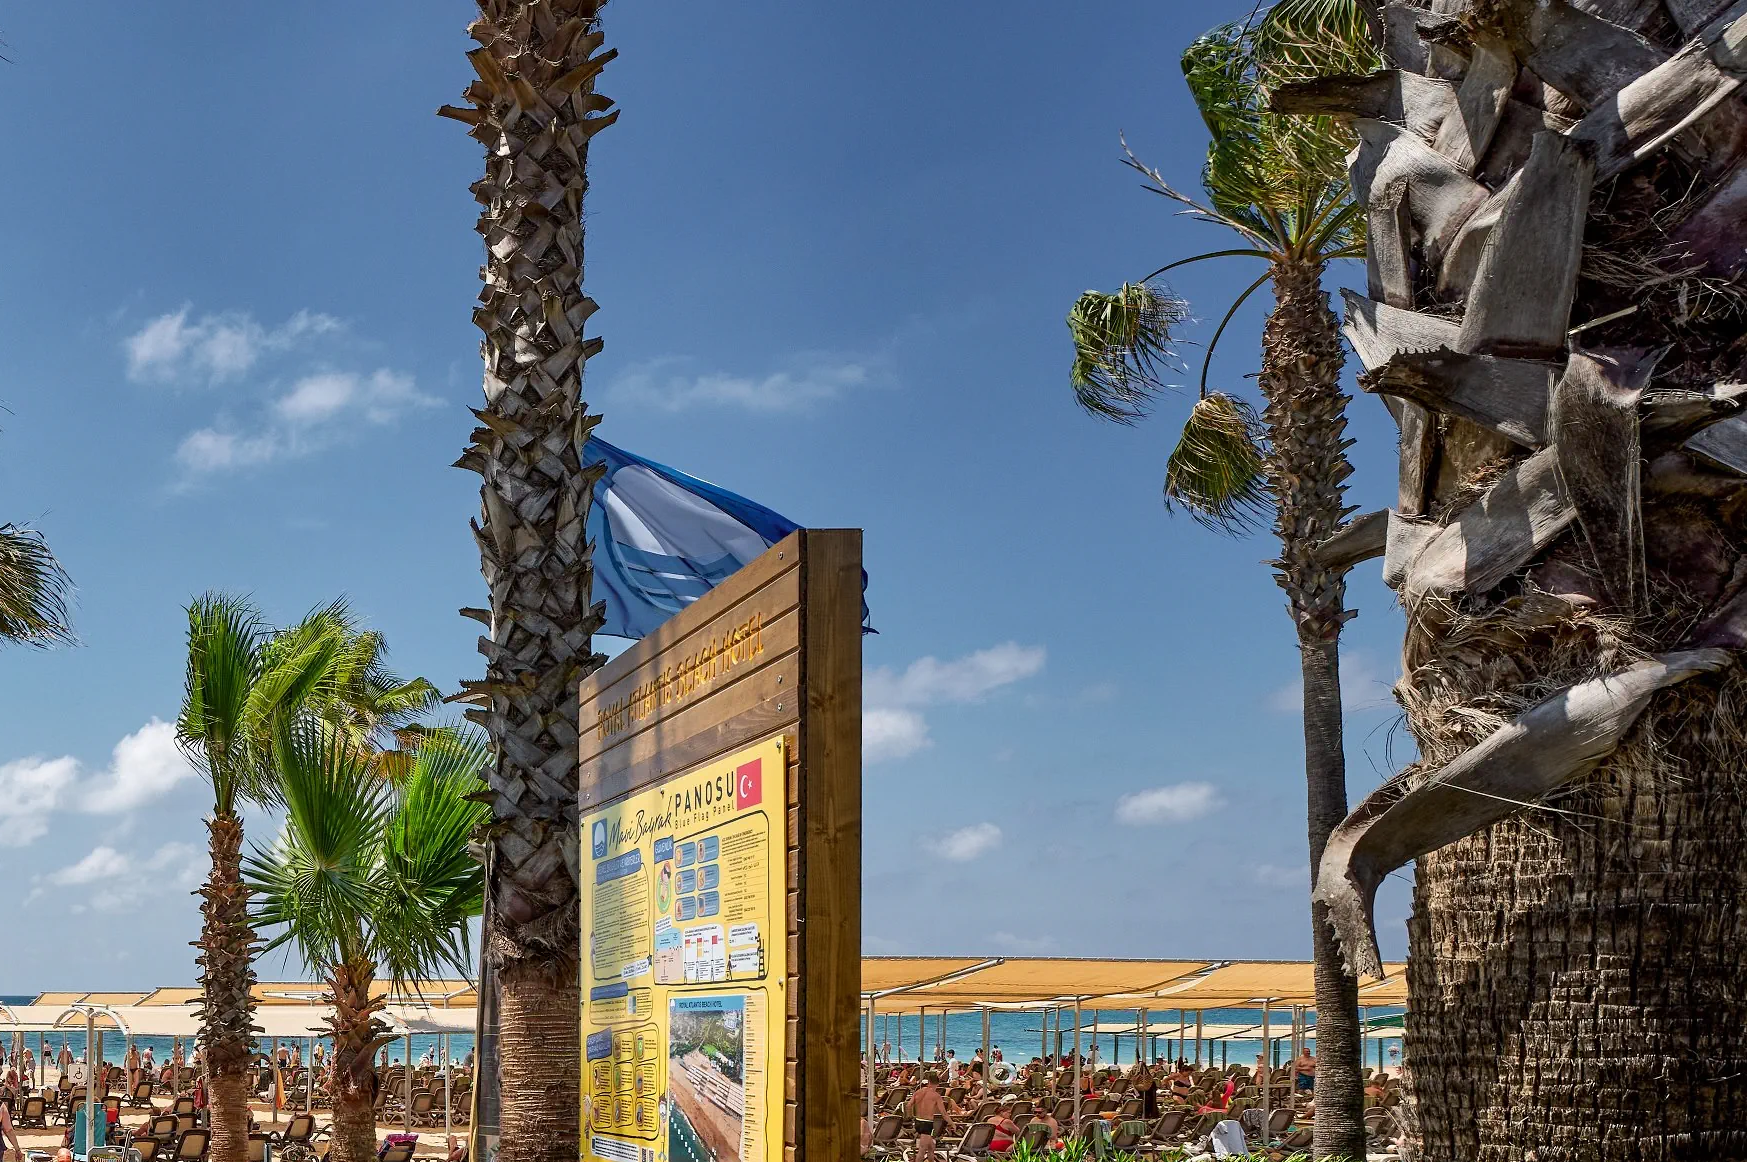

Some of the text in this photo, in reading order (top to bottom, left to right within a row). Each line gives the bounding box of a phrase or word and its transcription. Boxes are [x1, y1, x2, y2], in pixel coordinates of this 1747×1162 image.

[676, 638, 717, 703] BEACH
[722, 611, 765, 674] HOTEL
[675, 771, 734, 817] PANOSU
[675, 800, 734, 830] Blue Flag Panel
[609, 817, 634, 850] Mavi
[634, 796, 672, 848] Bayrak
